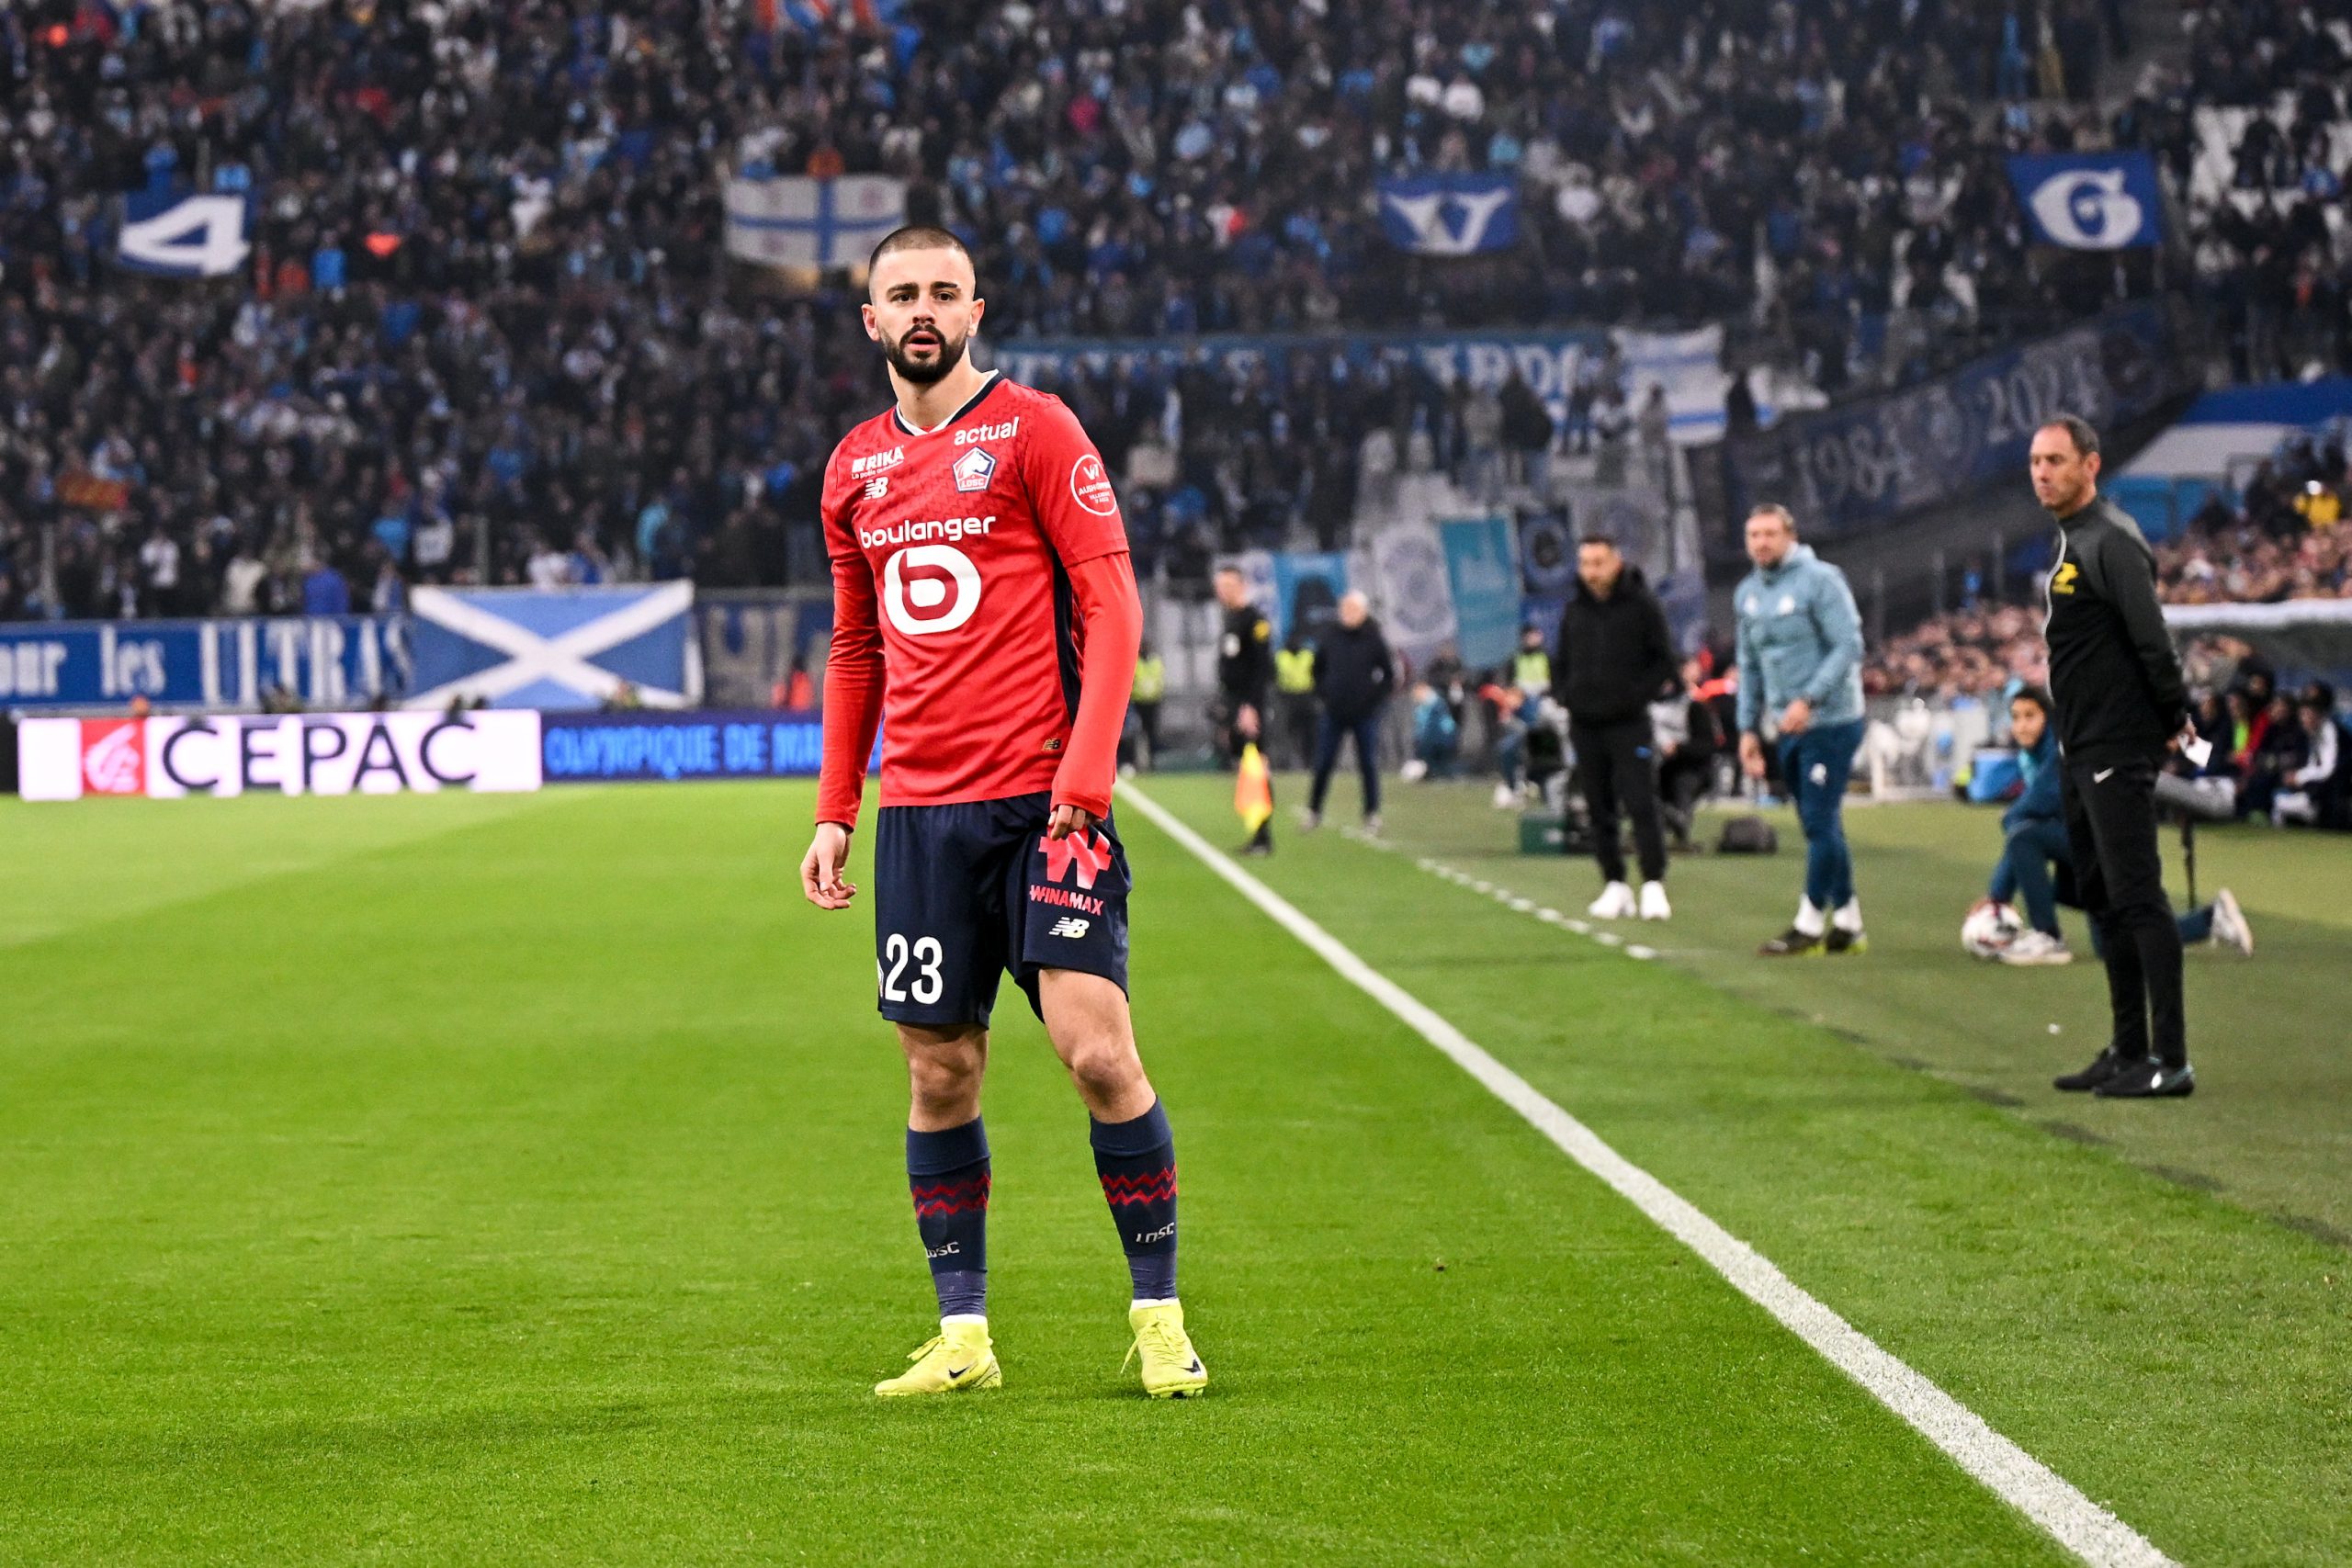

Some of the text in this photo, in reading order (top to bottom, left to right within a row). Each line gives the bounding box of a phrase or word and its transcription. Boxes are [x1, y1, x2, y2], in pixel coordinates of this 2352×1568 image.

[118, 195, 251, 276] 4
[954, 417, 1020, 446] actual
[865, 446, 905, 470] RIKA
[961, 478, 985, 488] LOSC
[860, 516, 996, 548] boulanger
[100, 624, 166, 698] les
[163, 723, 479, 791] CEPAC
[545, 725, 719, 779] OLYMPIQUE
[723, 722, 768, 773] DE
[1030, 885, 1103, 916] WINAMAX
[885, 933, 944, 1004] 23
